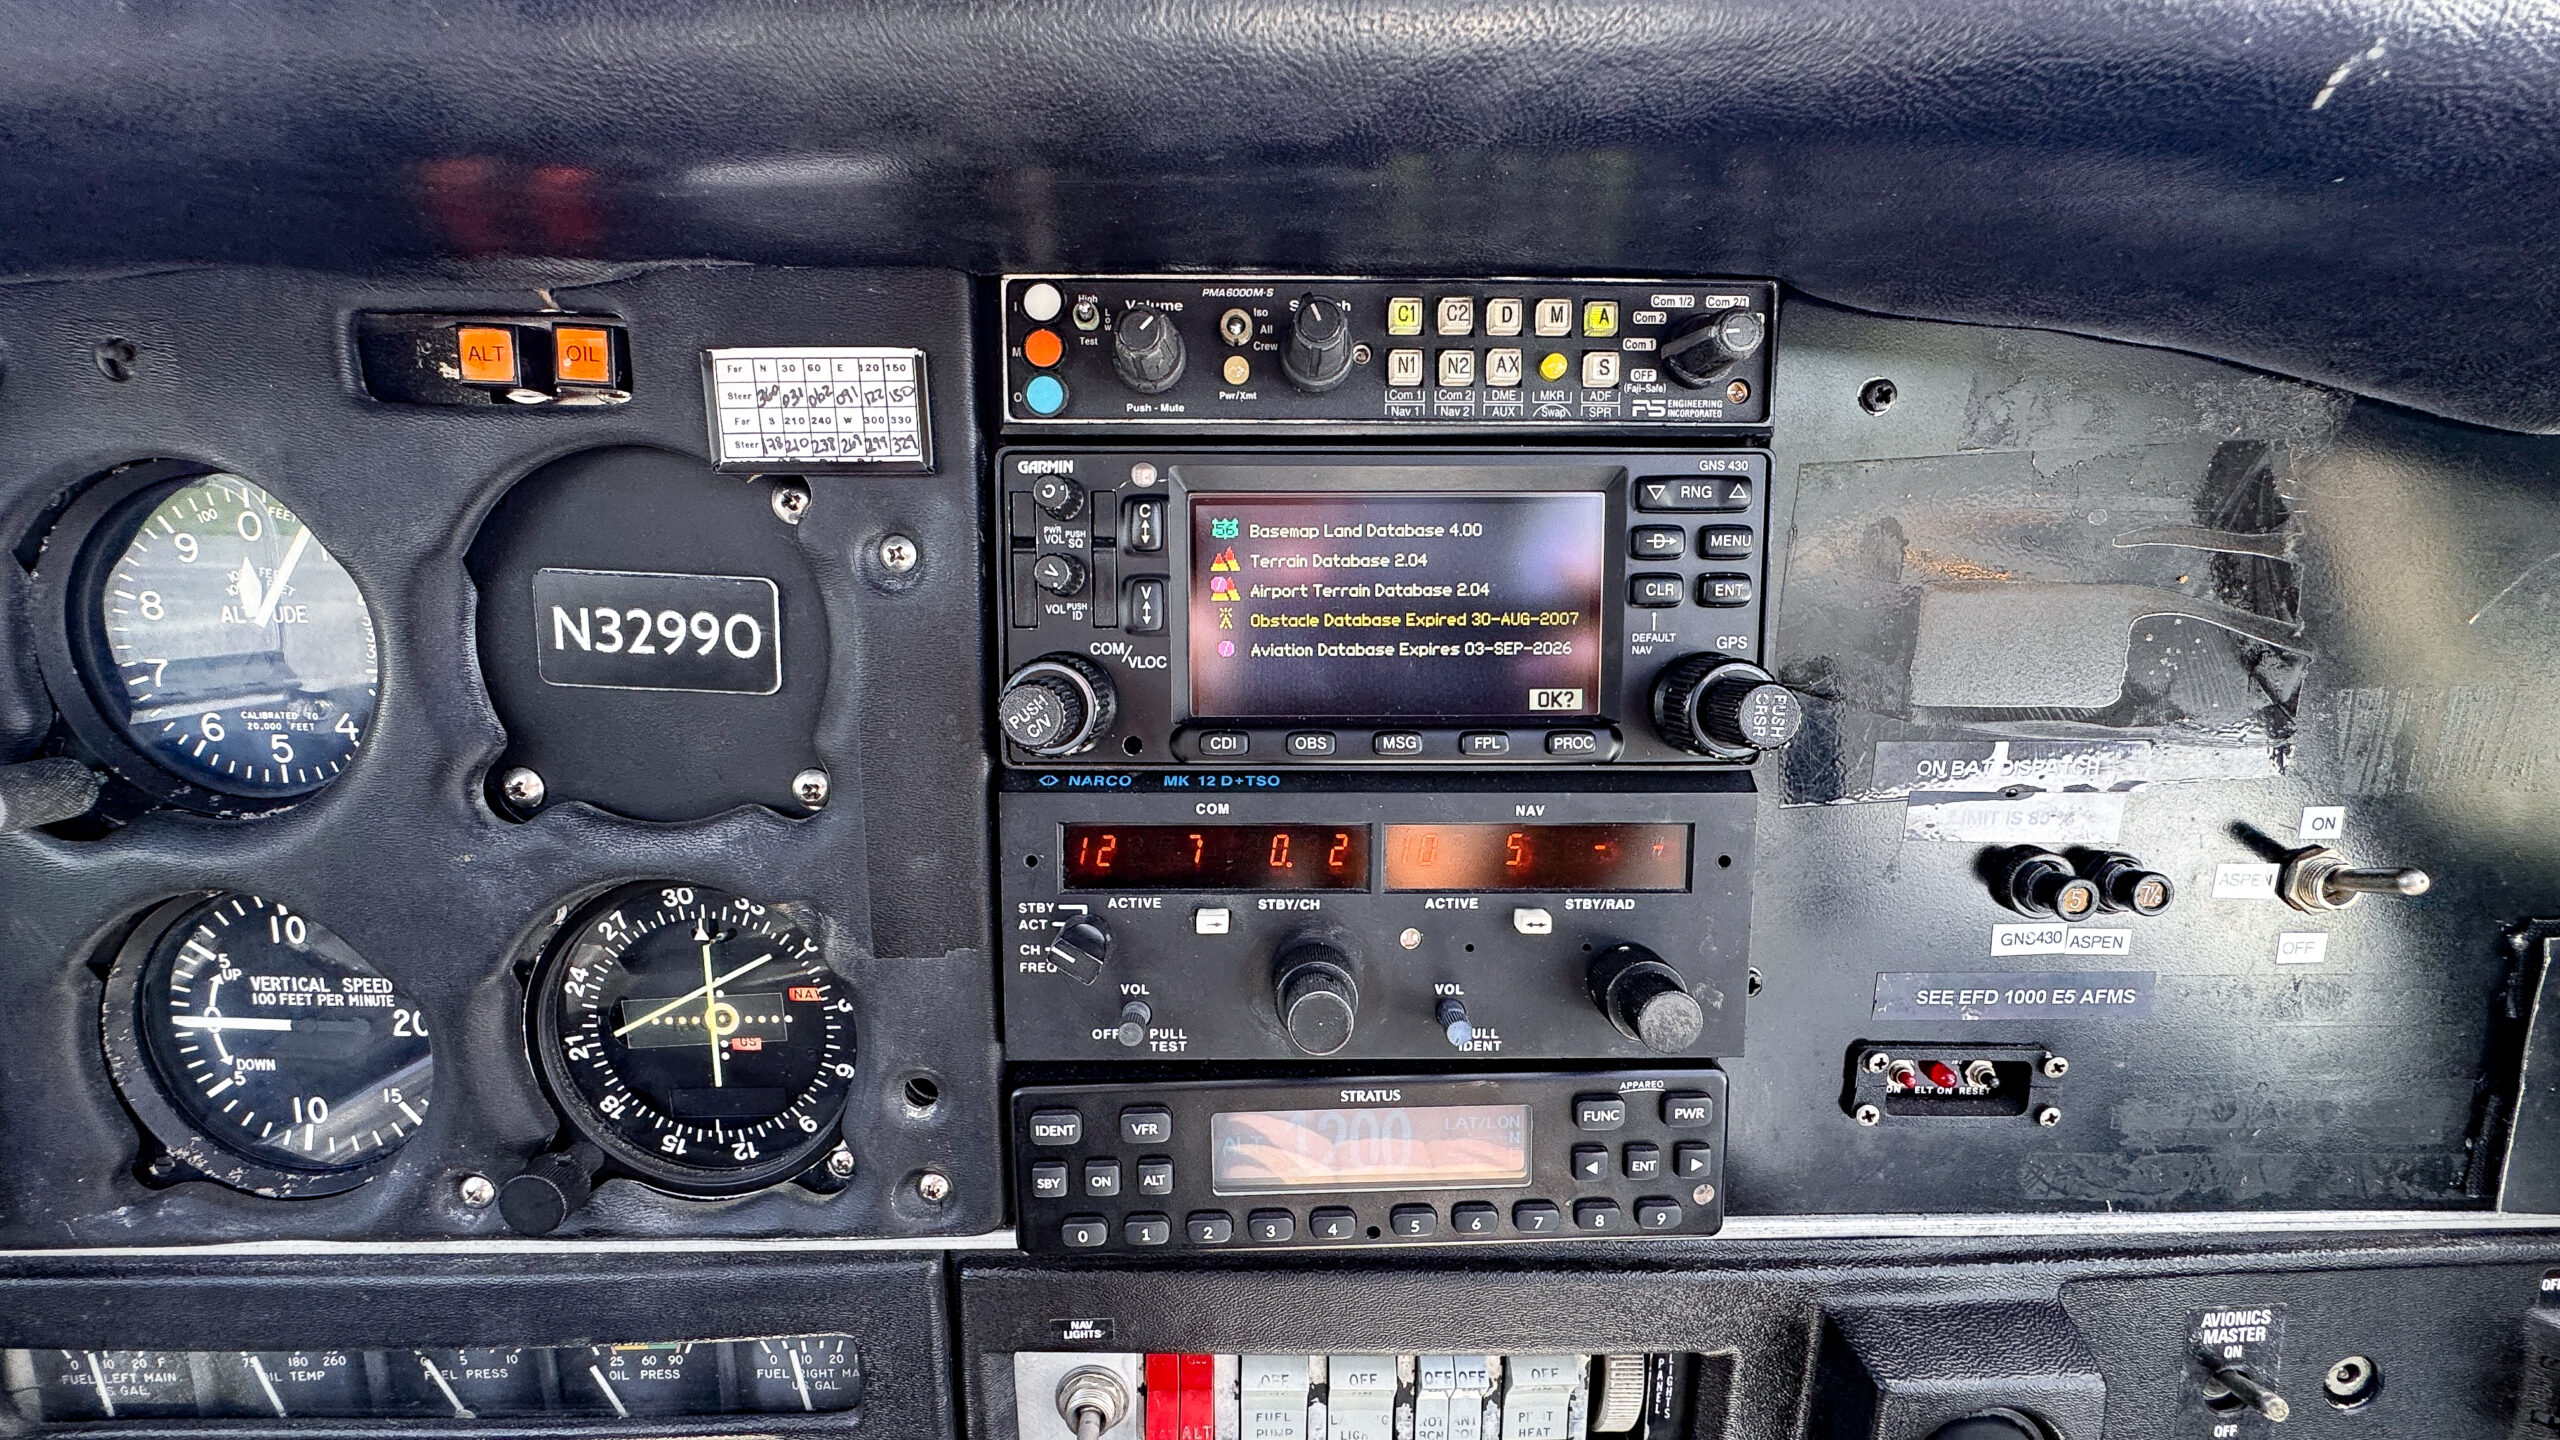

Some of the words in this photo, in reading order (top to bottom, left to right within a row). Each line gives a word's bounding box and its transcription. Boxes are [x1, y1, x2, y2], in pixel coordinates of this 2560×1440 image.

[1202, 288, 1274, 298] PMA6000M-S
[1653, 297, 1675, 307] Com
[1678, 296, 1692, 307] 1/2
[1398, 305, 1415, 322] C1
[1446, 304, 1470, 321] C2
[1502, 306, 1512, 323] D
[1079, 337, 1098, 346] Test
[1253, 341, 1278, 351] Crew
[468, 345, 504, 362] ALT
[566, 345, 599, 362] OIL
[727, 364, 743, 373] For
[782, 365, 795, 373] 30
[807, 364, 821, 372] 60
[837, 364, 844, 372] E
[860, 364, 880, 372] 120
[886, 364, 907, 372] 150
[1398, 357, 1415, 374] N1
[1448, 357, 1470, 374] N2
[1496, 355, 1520, 372] AX
[1633, 370, 1653, 380] OFF
[727, 392, 753, 400] Steer
[783, 387, 804, 408] 031
[836, 385, 858, 405] 091
[865, 387, 885, 406] 122
[889, 386, 915, 403] 150
[1219, 391, 1257, 401] Pwr/Xmt
[1492, 391, 1515, 401] DME
[1540, 391, 1564, 401] MKR
[1589, 391, 1611, 401] ADF
[1126, 403, 1150, 412] Push
[1161, 403, 1184, 412] Mute
[1667, 400, 1722, 409] ENGINEERING
[1492, 406, 1515, 417] AUX
[1589, 407, 1611, 418] SPR
[1667, 409, 1722, 418] INCORPORATED
[1018, 460, 1074, 473] GARMIN
[1699, 460, 1725, 471] GNS
[1728, 460, 1749, 471] 430
[1681, 486, 1712, 498] RNG
[1216, 523, 1235, 536] 56
[1250, 524, 1319, 539] Basemap
[1325, 524, 1362, 537] Land
[1367, 524, 1444, 537] Database
[1450, 523, 1483, 536] 4.00
[1068, 538, 1084, 549] SQ
[1711, 535, 1752, 547] MENU
[174, 532, 198, 563] 9
[1250, 554, 1308, 568] Terrain
[1313, 554, 1390, 568] Database
[1395, 554, 1428, 567] 2.04
[1250, 584, 1308, 599] Airport
[1314, 584, 1370, 598] Terrain
[1375, 584, 1452, 597] Database
[1457, 583, 1490, 597] 2.04
[1646, 584, 1674, 596] CLR
[1715, 584, 1744, 596] ENT
[140, 591, 164, 620] 8
[1250, 613, 1319, 627] Obstacle
[1325, 613, 1401, 627] Database
[1406, 613, 1467, 629] Expired
[1471, 612, 1579, 626] 30-AUG-2007
[551, 605, 760, 659] N32990
[1632, 633, 1677, 643] DEFAULT
[1716, 636, 1748, 649] GPS
[1250, 643, 1313, 657] Aviation
[1318, 643, 1395, 657] Database
[1399, 642, 1460, 658] Expires
[1465, 641, 1572, 656] 03-SEP-2026
[1632, 645, 1653, 655] NAV
[1537, 691, 1574, 708] OK?
[241, 711, 298, 721] CALIBRATED
[307, 711, 319, 721] TO
[1753, 693, 1769, 737] CRSR
[1771, 693, 1787, 738] PUSH
[200, 712, 225, 741] 6
[290, 722, 314, 731] FEET
[335, 713, 359, 741] 4
[271, 734, 294, 763] 5
[1210, 737, 1237, 750] CDI
[1294, 737, 1327, 750] OBS
[1383, 737, 1417, 750] MSG
[1475, 737, 1501, 750] FPL
[1553, 737, 1594, 750] PROC
[1917, 760, 1948, 776] ON
[1952, 760, 1993, 777] BAT
[2001, 759, 2101, 777] DISPATCH
[1068, 775, 1132, 787] NARCO
[1163, 775, 1189, 787] MK
[1198, 775, 1216, 787] 12
[1221, 775, 1280, 787] D+TSO
[1195, 803, 1230, 815] COM
[1516, 805, 1545, 817] NAV
[2312, 817, 2336, 831] ON
[661, 888, 694, 908] 30
[1107, 897, 1162, 909] ACTIVE
[1424, 898, 1479, 910] ACTIVE
[1018, 902, 1054, 913] STBY
[1258, 899, 1320, 911] STBY/CH
[1565, 898, 1636, 911] STBY/RAD
[270, 915, 307, 945] 10
[1018, 919, 1048, 930] ACT
[2000, 930, 2063, 946] GNS430
[2069, 935, 2124, 949] ASPEN
[223, 969, 242, 980] UP
[249, 976, 331, 992] VERTICAL
[342, 978, 394, 994] SPEED
[1120, 984, 1150, 995] VOL
[252, 993, 277, 1005] 100
[280, 993, 312, 1006] FEET
[317, 994, 345, 1006] PER
[349, 994, 396, 1008] MINUTE
[1916, 989, 1954, 1006] SEE
[1958, 989, 1999, 1005] EFD
[2004, 989, 2047, 1005] 1000
[2051, 989, 2076, 1005] E5
[2079, 989, 2136, 1005] AFMS
[1149, 1029, 1187, 1040] PULL
[1149, 1041, 1187, 1052] TEST
[236, 1059, 277, 1071] DOWN
[1620, 1080, 1665, 1090] APPAREO
[1914, 1086, 1934, 1094] ELT
[1937, 1087, 1953, 1095] ON
[1341, 1090, 1401, 1102] STRATUS
[293, 1096, 329, 1124] 10
[1583, 1109, 1620, 1122] FUNC
[1674, 1107, 1705, 1120] PWR
[1035, 1124, 1076, 1137] IDENT
[1132, 1123, 1159, 1135] VFR
[1632, 1160, 1657, 1172] ENT
[1037, 1177, 1061, 1189] SBY
[1092, 1176, 1112, 1187] ON
[1144, 1174, 1166, 1186] ALT
[2201, 1309, 2271, 1328] AVIONICS
[1071, 1321, 1093, 1330] NAV
[1064, 1329, 1102, 1340] LIGHTS
[2203, 1326, 2266, 1344] MASTER
[2224, 1345, 2242, 1358] ON
[610, 1355, 625, 1366] 25
[641, 1355, 657, 1366] 60
[667, 1355, 684, 1366] 90
[609, 1370, 630, 1381] OIL
[640, 1369, 680, 1380] PRESS
[2214, 1424, 2237, 1437] OFF
